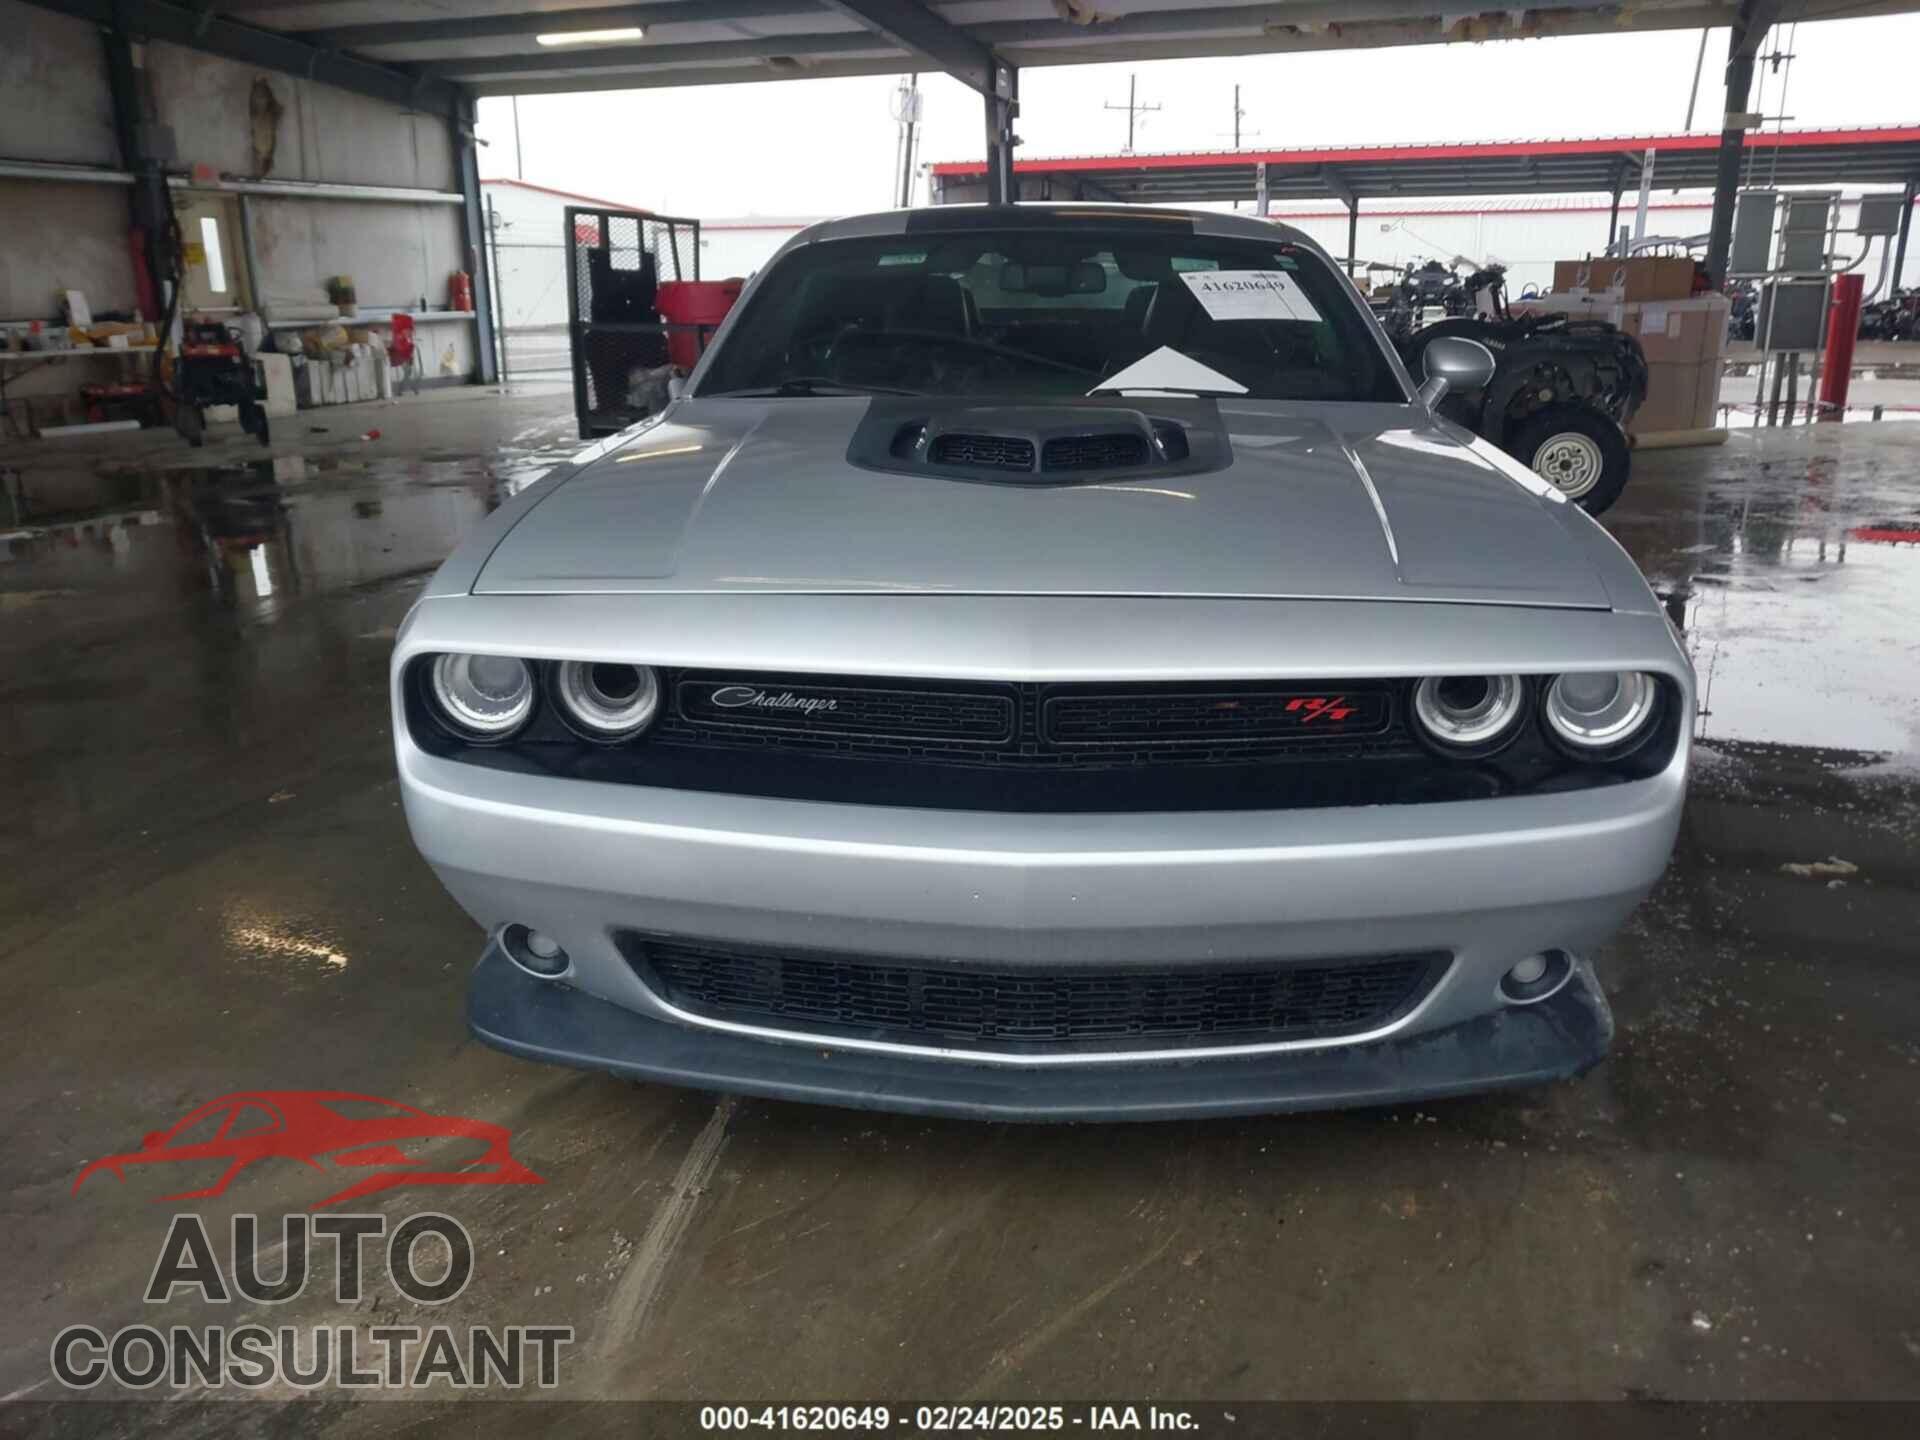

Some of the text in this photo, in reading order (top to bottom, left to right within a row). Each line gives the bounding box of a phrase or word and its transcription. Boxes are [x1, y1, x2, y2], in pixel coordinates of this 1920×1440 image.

[1201, 279, 1286, 293] 41620649
[711, 686, 839, 716] Challenger
[1285, 696, 1360, 722] R/T
